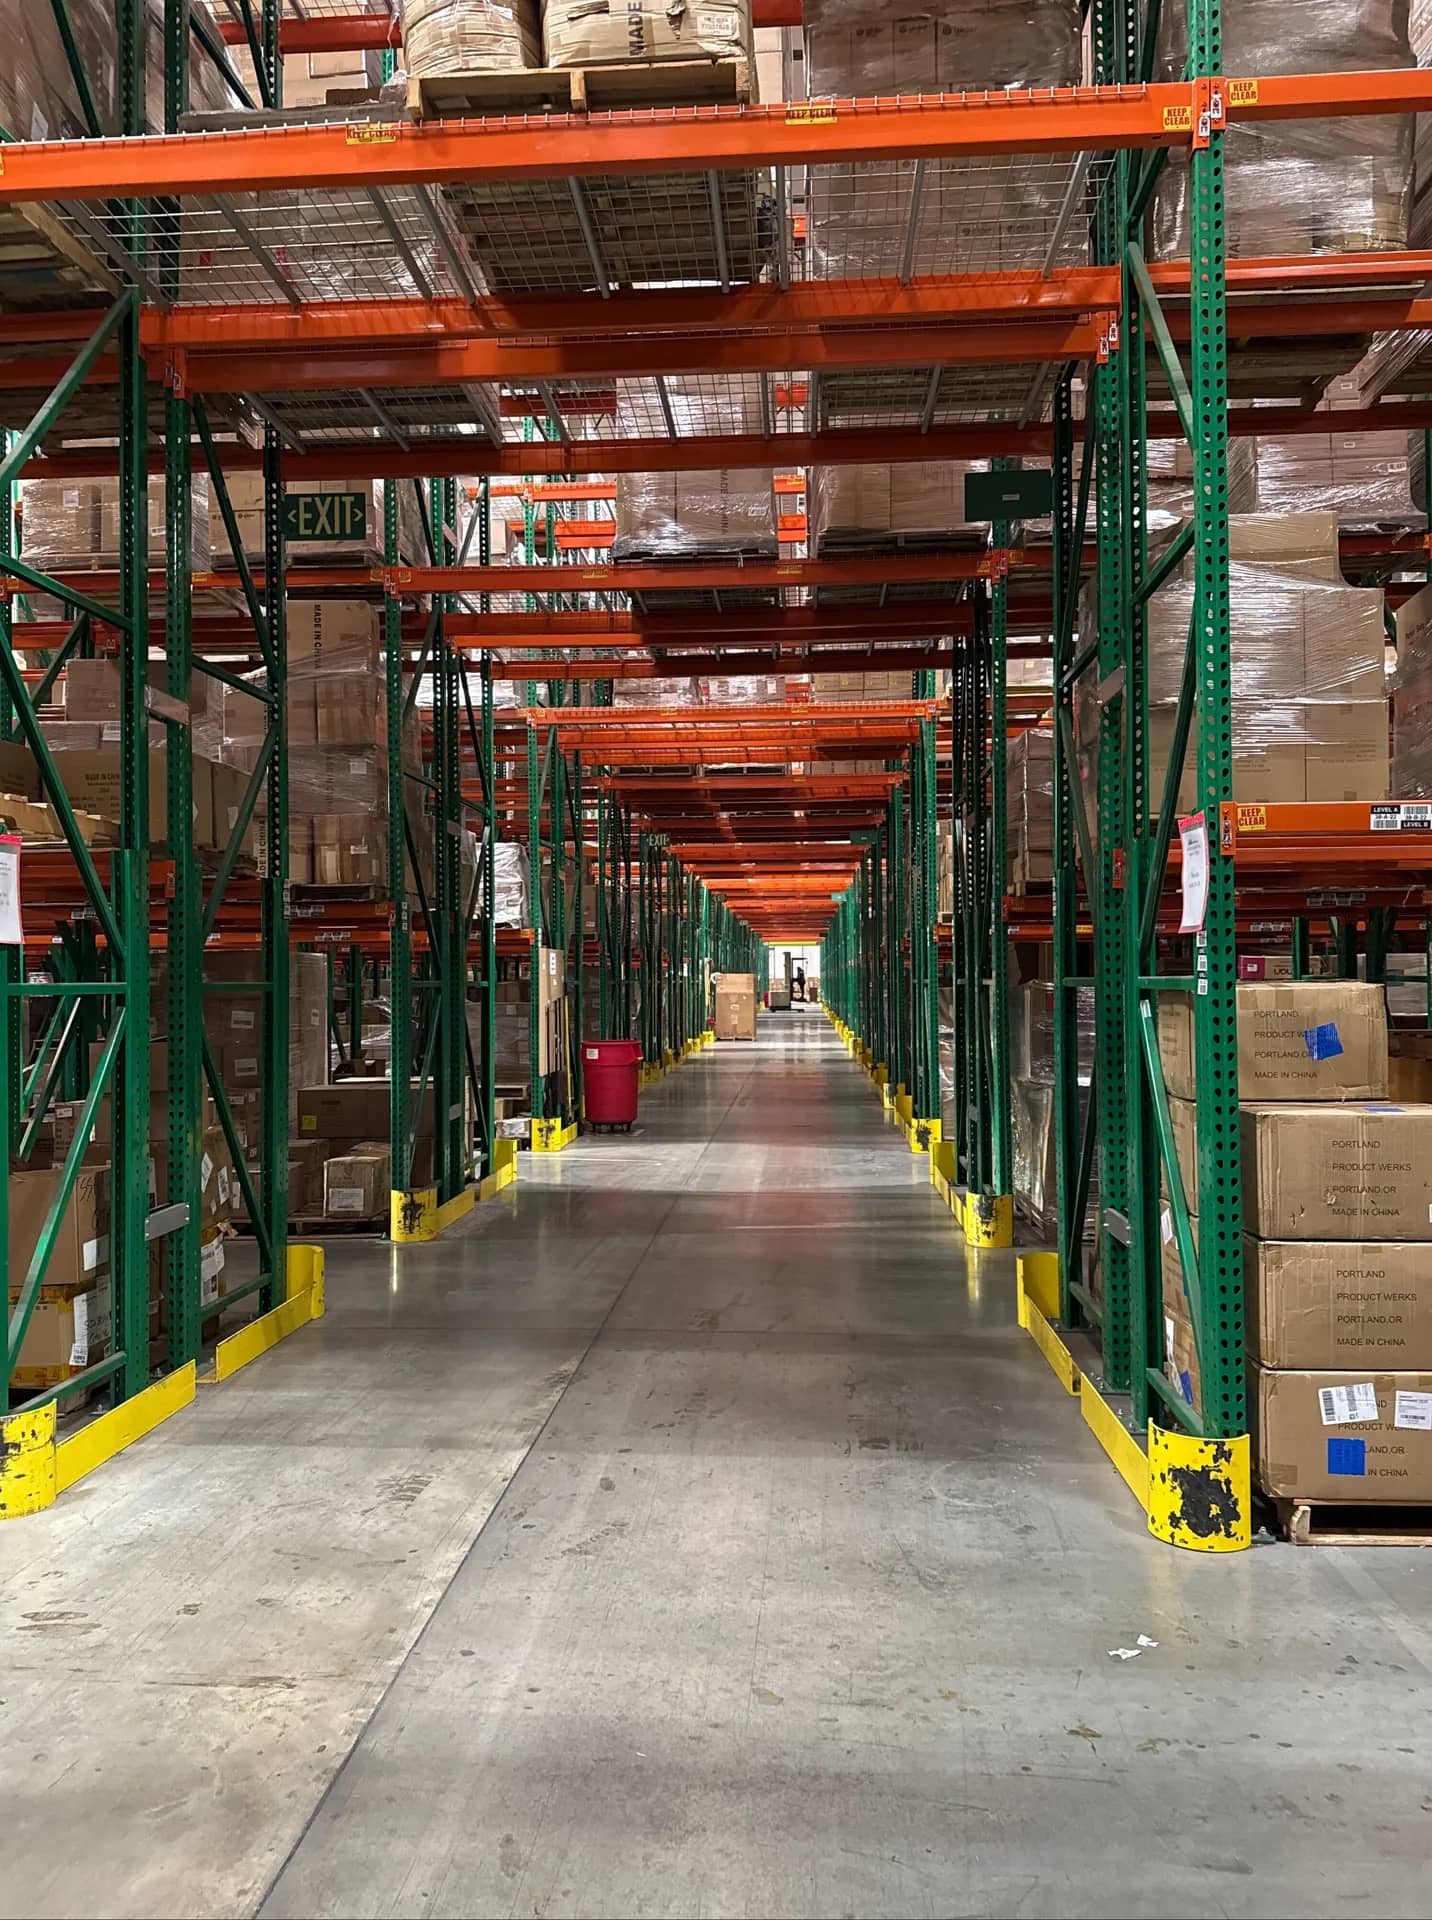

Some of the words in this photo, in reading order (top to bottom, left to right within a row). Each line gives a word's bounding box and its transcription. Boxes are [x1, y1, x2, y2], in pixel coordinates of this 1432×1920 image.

[628, 2, 644, 56] MADE
[1232, 82, 1254, 91] KEEP
[1230, 91, 1257, 101] CLEAR
[1166, 107, 1187, 116] KEEP
[1164, 116, 1190, 126] CLEAR
[298, 496, 355, 535] EXIT
[314, 604, 322, 628] MADE
[314, 630, 322, 640] IN
[1240, 808, 1262, 817] KEEP
[1238, 816, 1265, 826] CLEAR
[650, 834, 667, 846] EXIT
[1254, 1031, 1295, 1039] PRODUCT
[1332, 1141, 1381, 1149] PORTLAND
[1332, 1163, 1376, 1171] PRODUCT
[1378, 1163, 1412, 1171] WERKS
[1332, 1208, 1358, 1216] MADE
[1360, 1208, 1369, 1216] IN
[1371, 1208, 1400, 1216] CHINA
[1336, 1270, 1385, 1278] PORTLAND
[1336, 1293, 1381, 1301] PRODUCT
[1383, 1293, 1417, 1301] WERKS
[1336, 1338, 1363, 1346] MADE
[1365, 1338, 1375, 1346] IN
[1377, 1338, 1406, 1346] CHINA
[1338, 1423, 1383, 1431] PRODUCT
[1367, 1469, 1377, 1477] IN
[1379, 1469, 1408, 1477] CHINA
